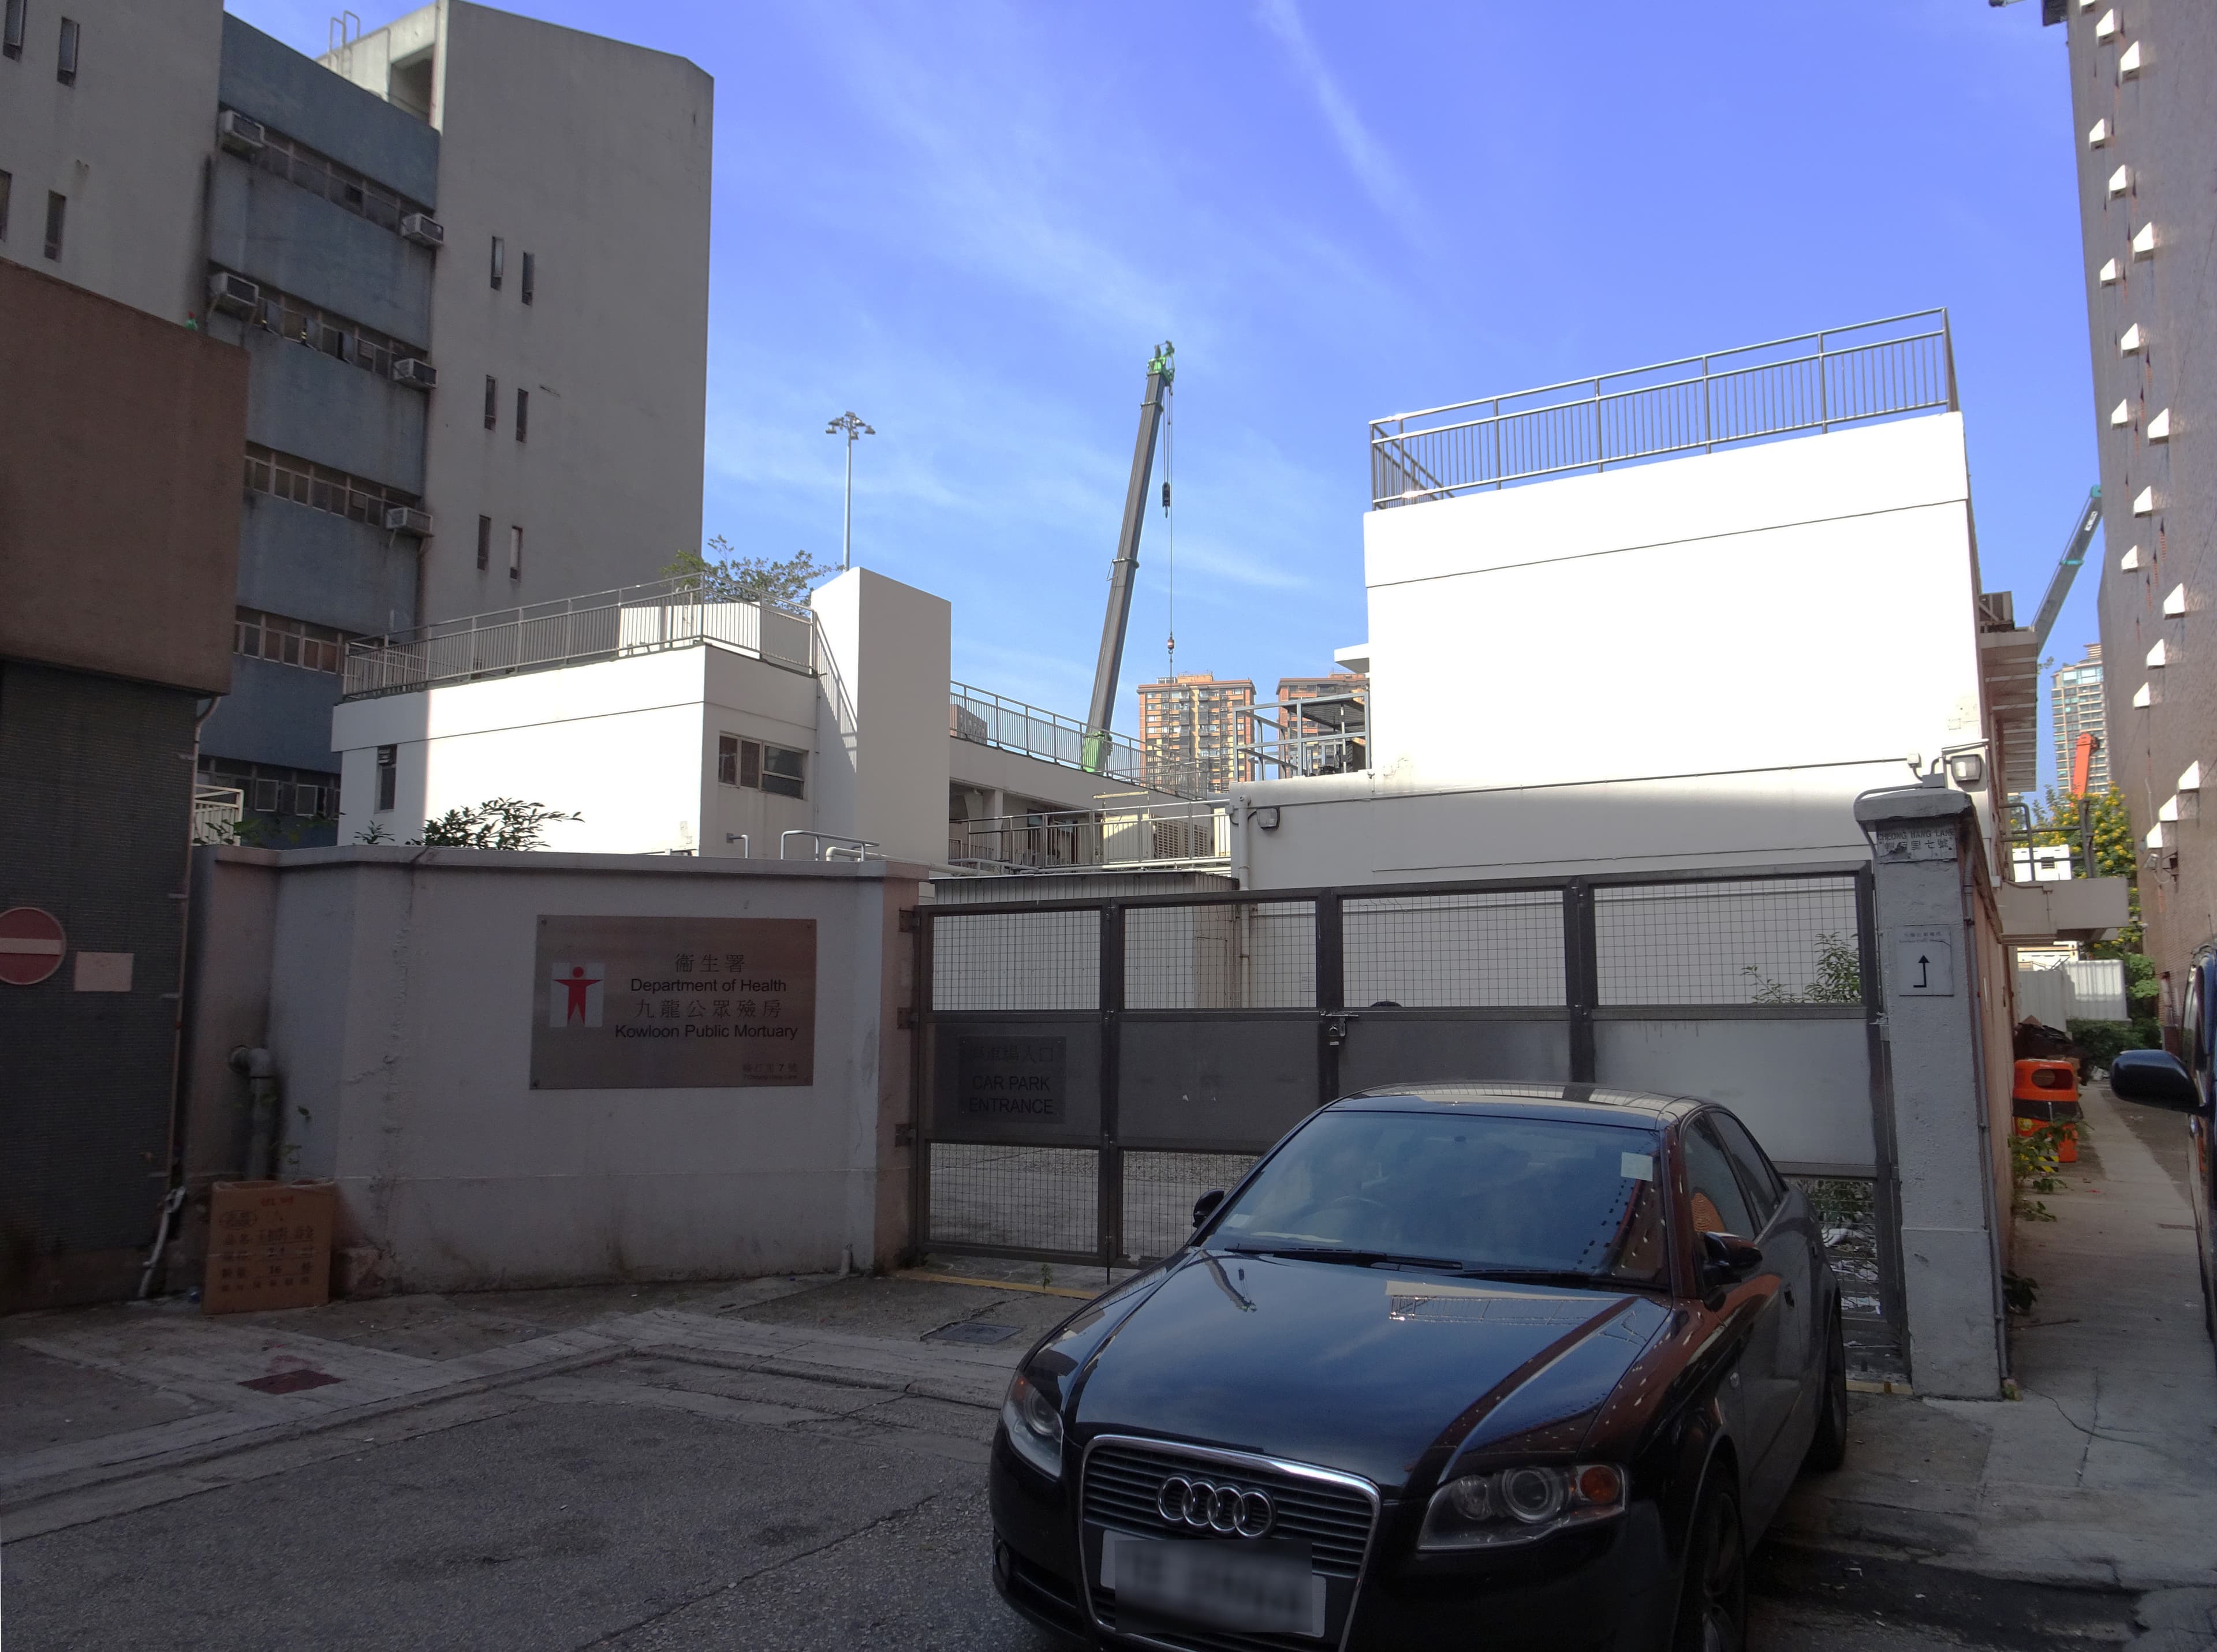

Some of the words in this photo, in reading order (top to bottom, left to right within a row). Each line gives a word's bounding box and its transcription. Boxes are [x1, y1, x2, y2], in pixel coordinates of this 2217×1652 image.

[632, 978, 716, 994] Department
[722, 978, 737, 992] of
[741, 978, 786, 992] Health
[615, 1025, 679, 1038] Kowloon
[685, 1025, 729, 1038] Public
[735, 1025, 798, 1040] Mortuary
[973, 1076, 1003, 1090] CAR
[1009, 1076, 1051, 1092] PARK
[969, 1098, 1054, 1114] ENTRANCE
